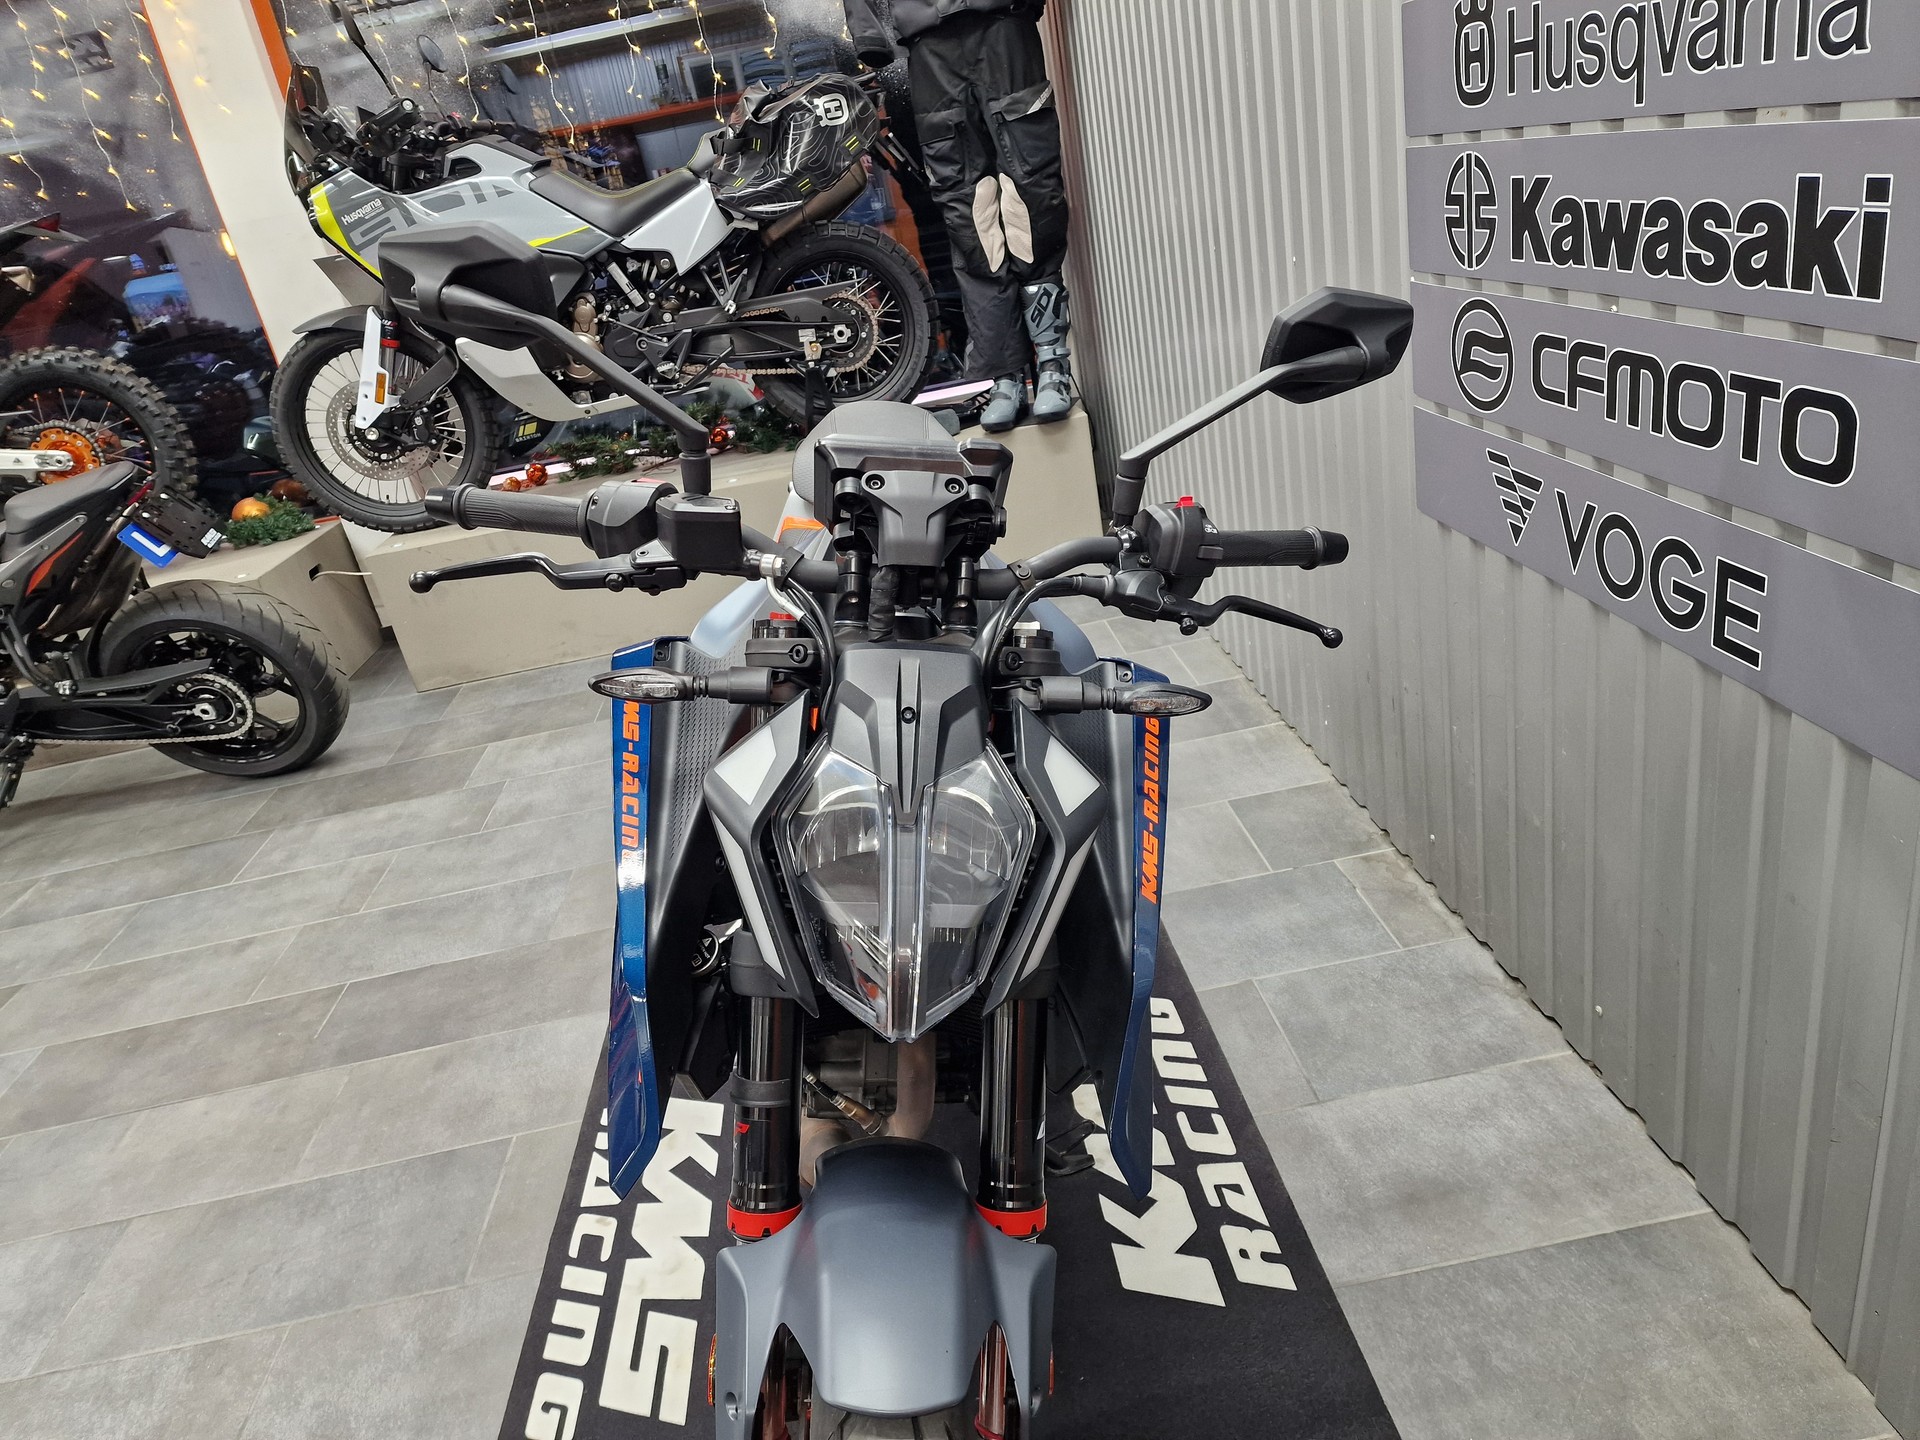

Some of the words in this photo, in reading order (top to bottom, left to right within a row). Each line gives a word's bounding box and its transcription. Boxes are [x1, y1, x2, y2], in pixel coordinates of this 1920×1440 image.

[1506, 0, 1871, 107] Husqvarna
[341, 198, 382, 226] Husqvarna
[1510, 173, 1893, 303] Kawasaki
[1531, 332, 1859, 487] CFMOTO
[1555, 488, 1768, 671] VOGE
[524, 1107, 622, 1440] ACING
